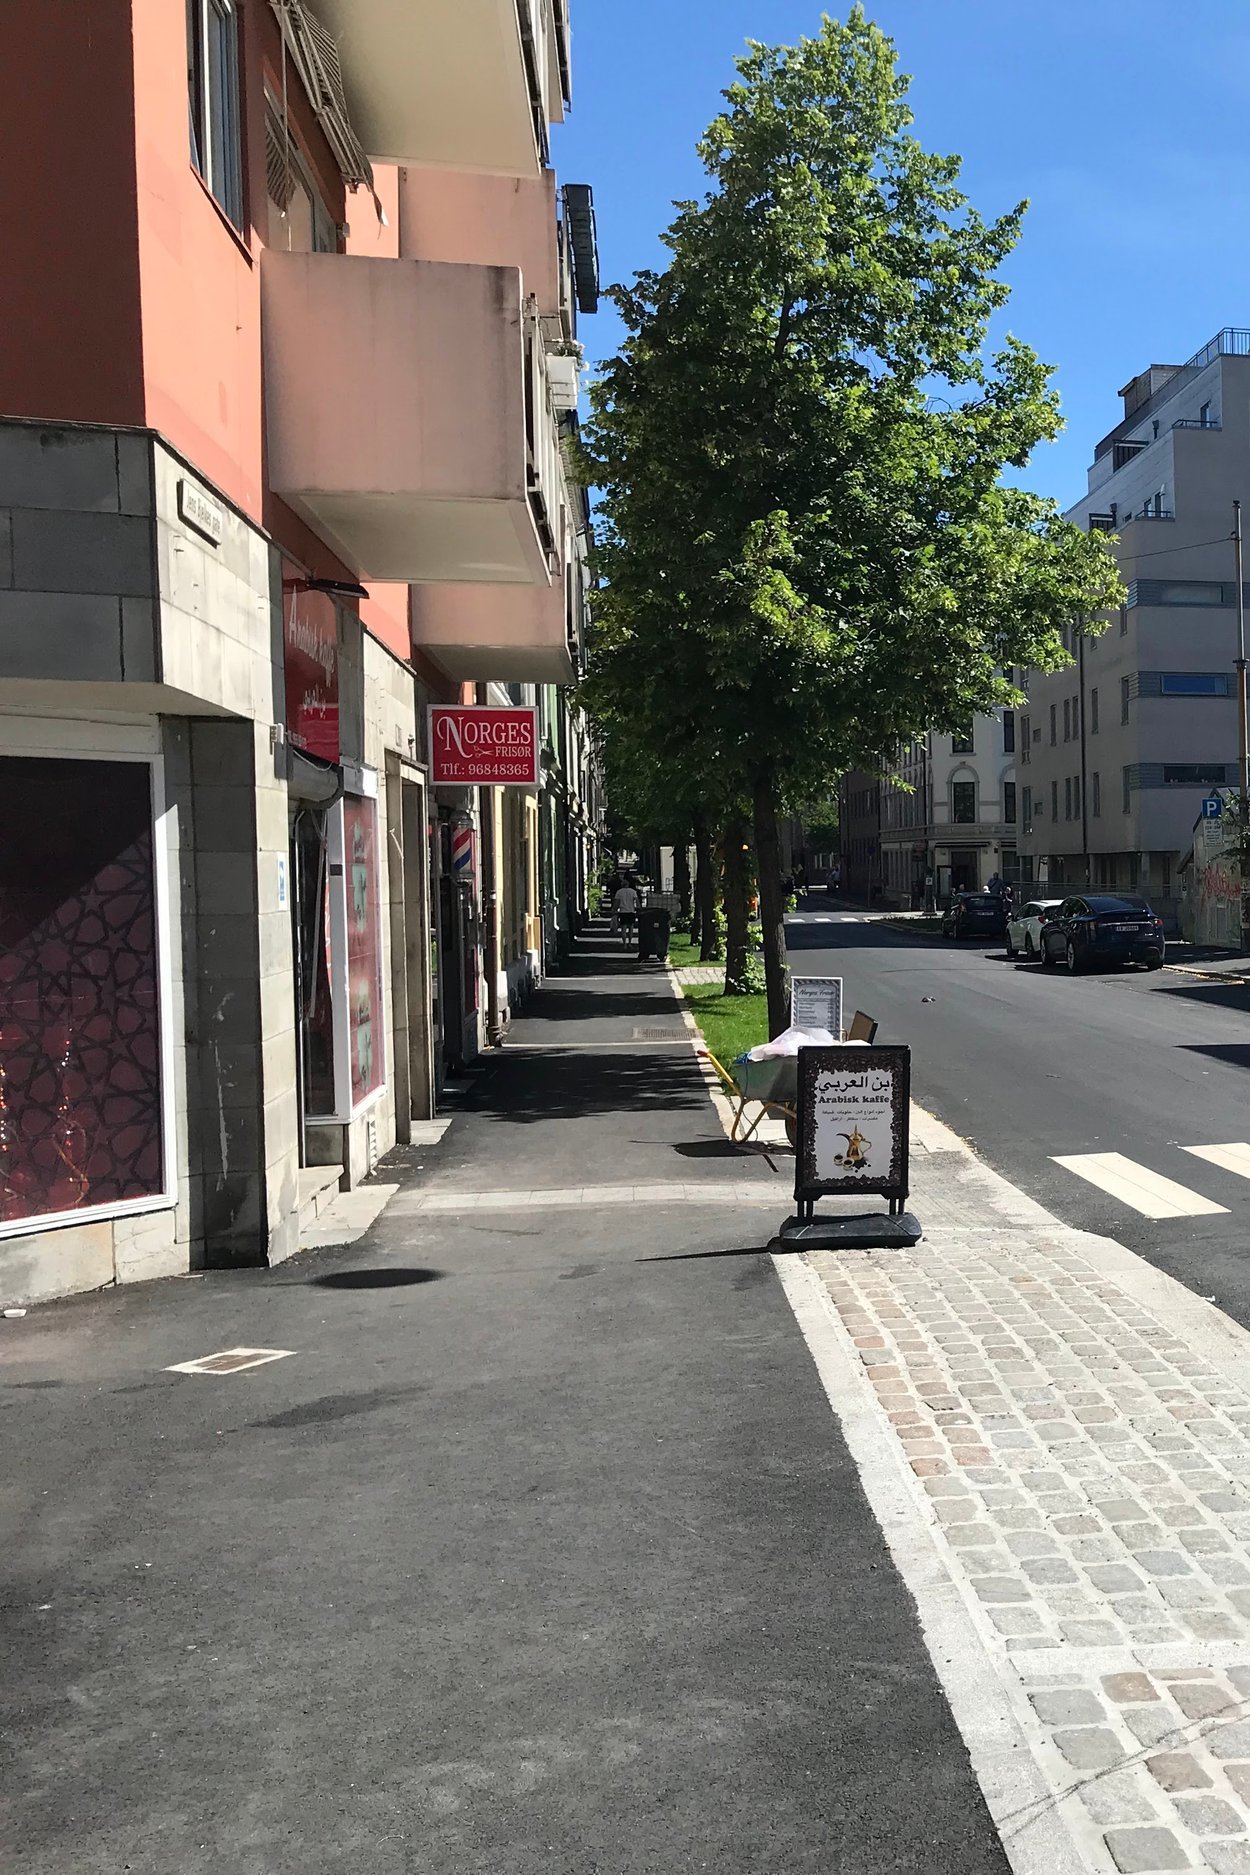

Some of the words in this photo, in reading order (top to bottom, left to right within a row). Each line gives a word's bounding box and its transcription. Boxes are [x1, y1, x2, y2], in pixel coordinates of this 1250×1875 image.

[436, 716, 531, 758] NORGES
[495, 746, 532, 758] FRISØR
[440, 763, 465, 775] Tlf.:
[468, 763, 530, 775] 96848365
[1206, 801, 1217, 817] P
[818, 1075, 869, 1094] العربي
[871, 1076, 890, 1091] بن
[818, 1095, 860, 1104] Arabisk
[862, 1095, 890, 1104] kaffe
